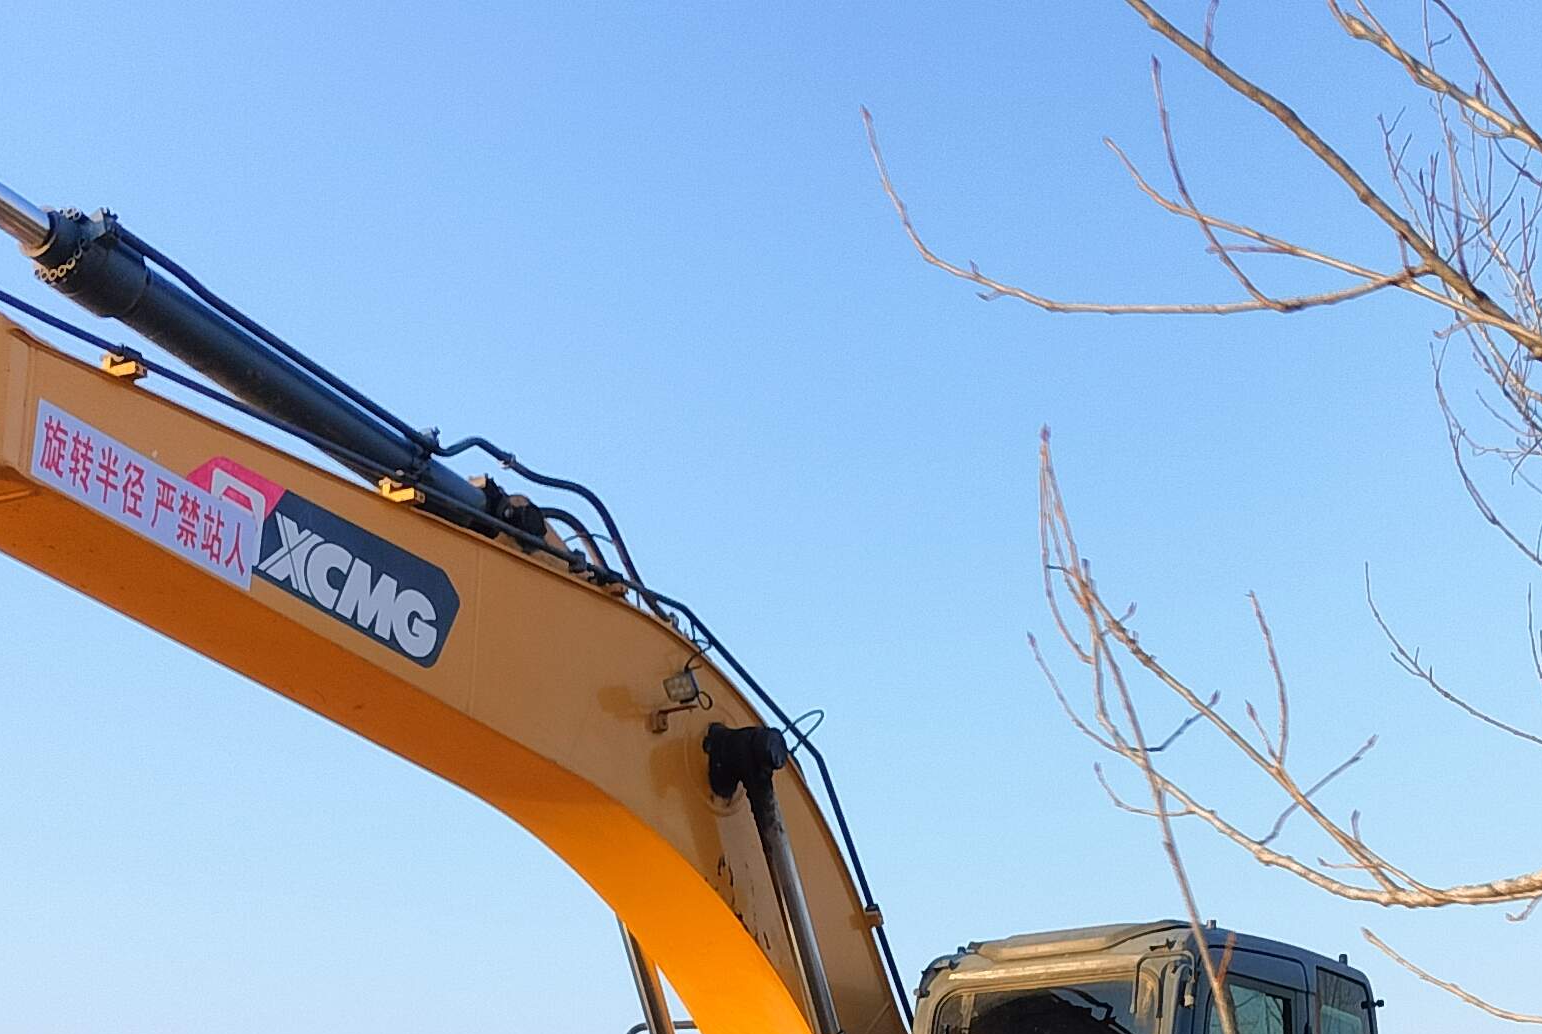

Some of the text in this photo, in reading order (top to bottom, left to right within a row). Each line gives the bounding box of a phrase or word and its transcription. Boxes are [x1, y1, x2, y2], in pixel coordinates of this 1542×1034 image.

[40, 416, 245, 576] 旋转半径 严禁站人
[258, 511, 437, 658] XCMG
